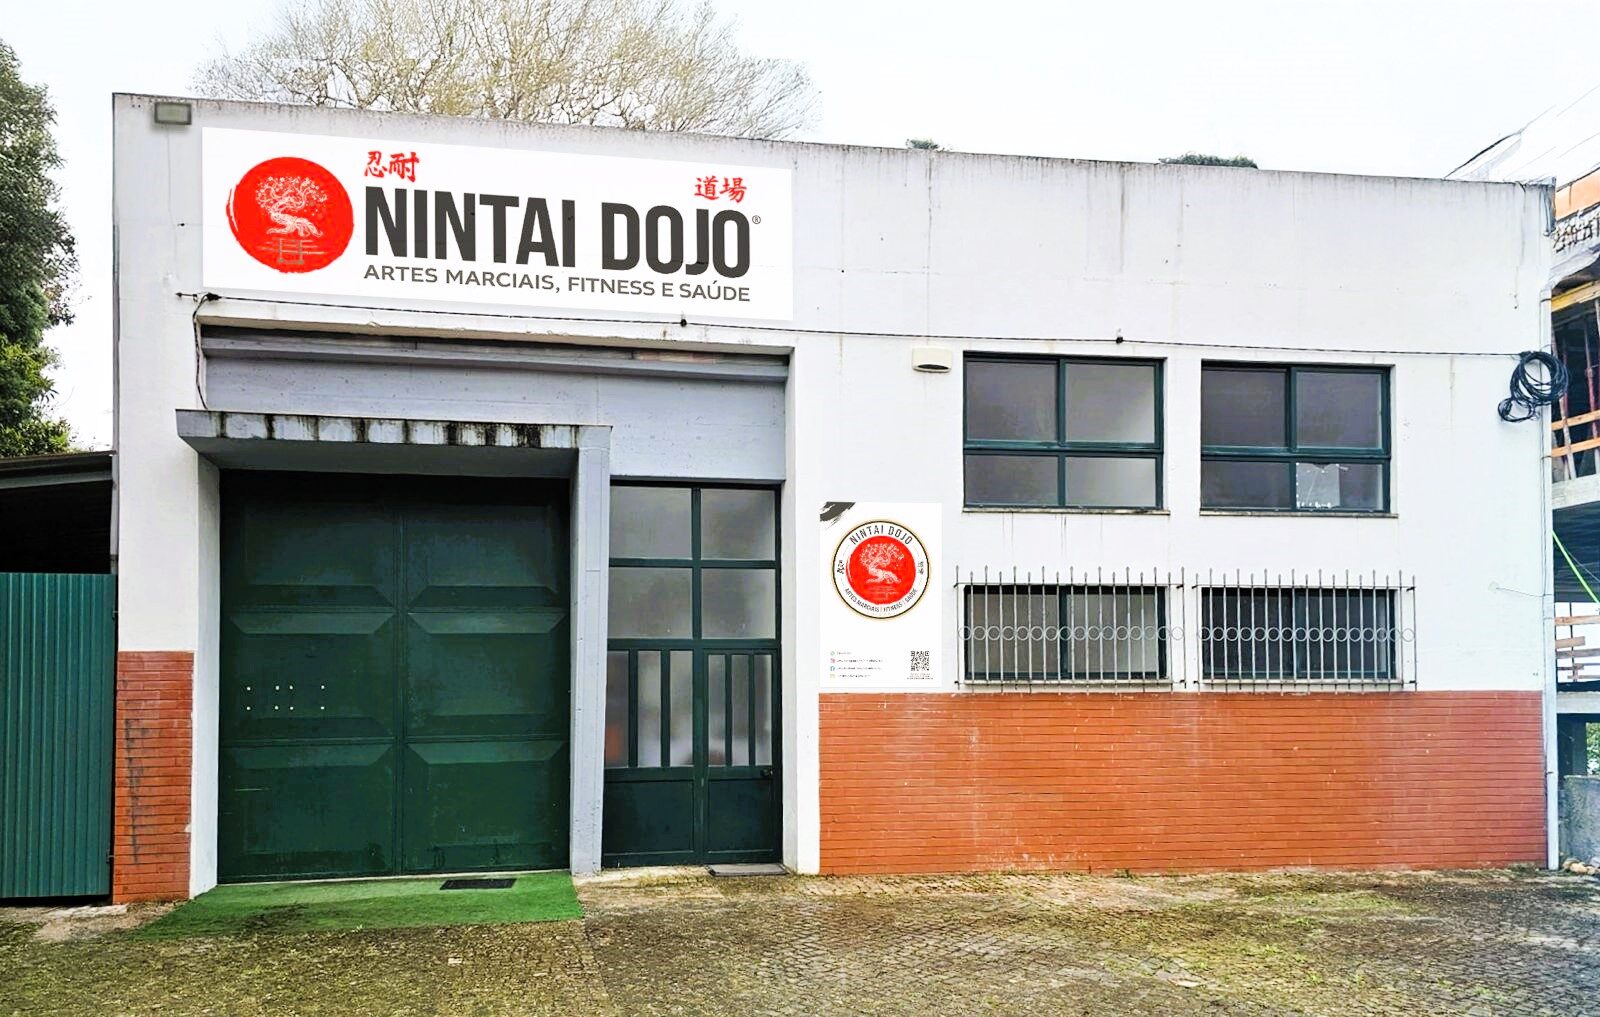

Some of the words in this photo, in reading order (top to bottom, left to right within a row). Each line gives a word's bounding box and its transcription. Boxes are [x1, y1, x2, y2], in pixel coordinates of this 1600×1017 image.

[364, 151, 420, 184] 忍耐
[694, 176, 748, 204] 道場
[365, 185, 576, 269] NINTAI
[364, 264, 438, 284] ARTES
[446, 269, 561, 295] MARCIAIS,
[568, 277, 656, 297] FITNESS
[662, 282, 674, 298] E
[679, 280, 751, 302] SAÚDE
[849, 524, 884, 545] NINTAI
[887, 525, 913, 545] DOJO
